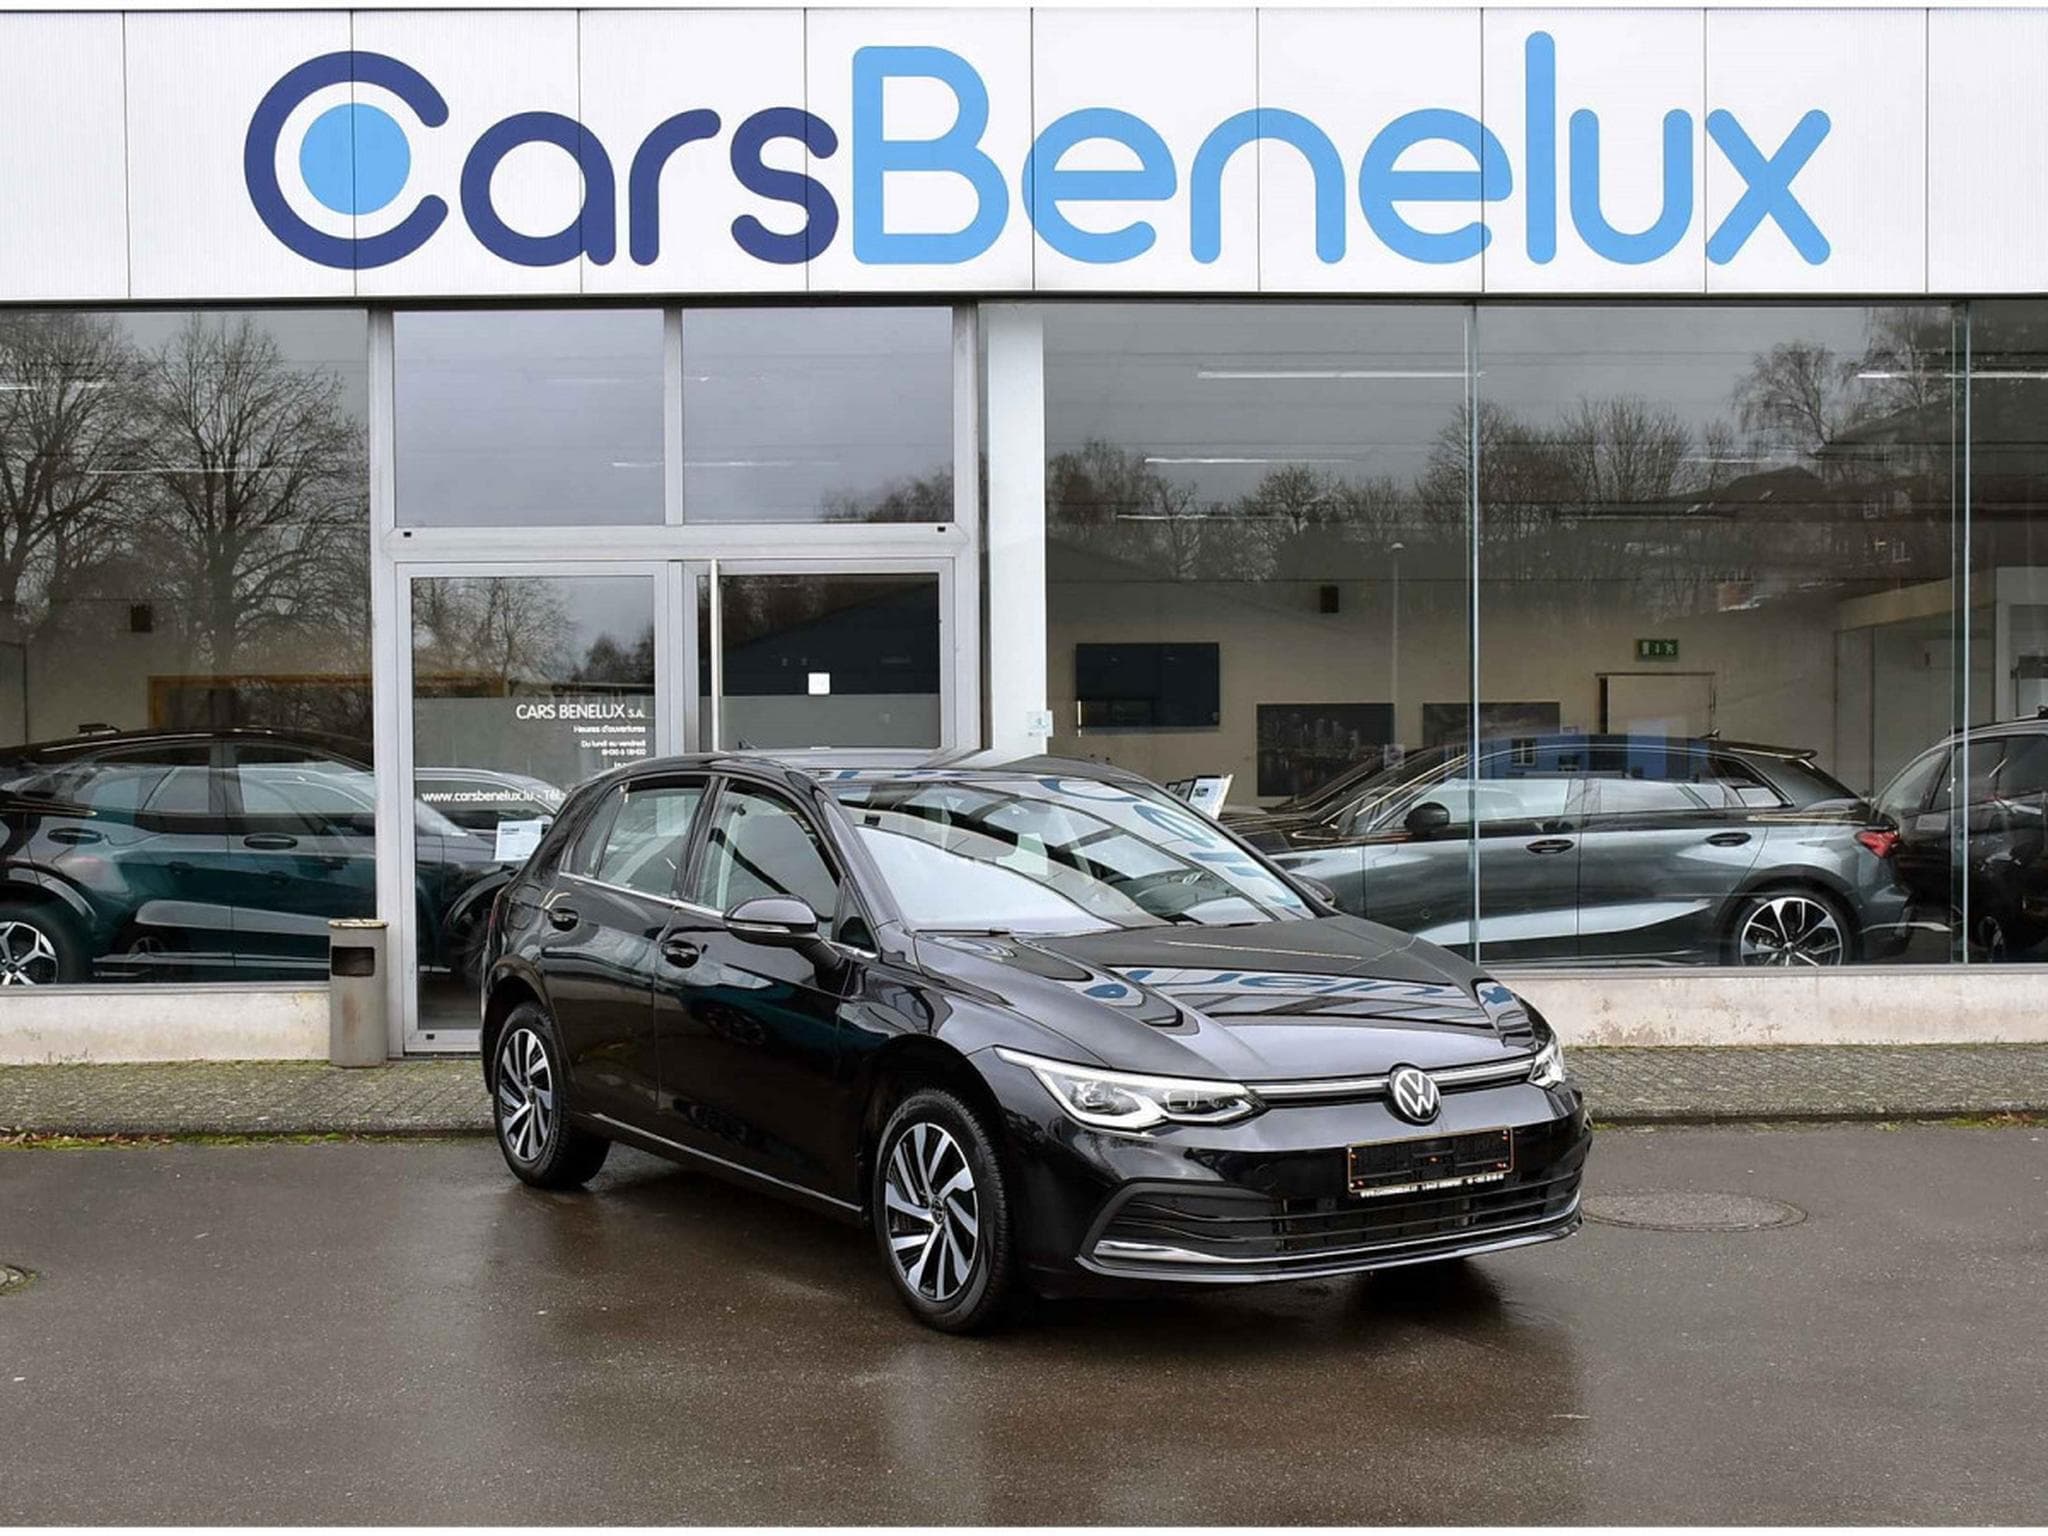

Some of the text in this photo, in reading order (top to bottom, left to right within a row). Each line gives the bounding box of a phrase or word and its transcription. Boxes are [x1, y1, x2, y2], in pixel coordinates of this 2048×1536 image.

[515, 704, 556, 720] CARS
[559, 703, 626, 719] BENELUX
[421, 789, 534, 802] www.carsbenelux.lu
